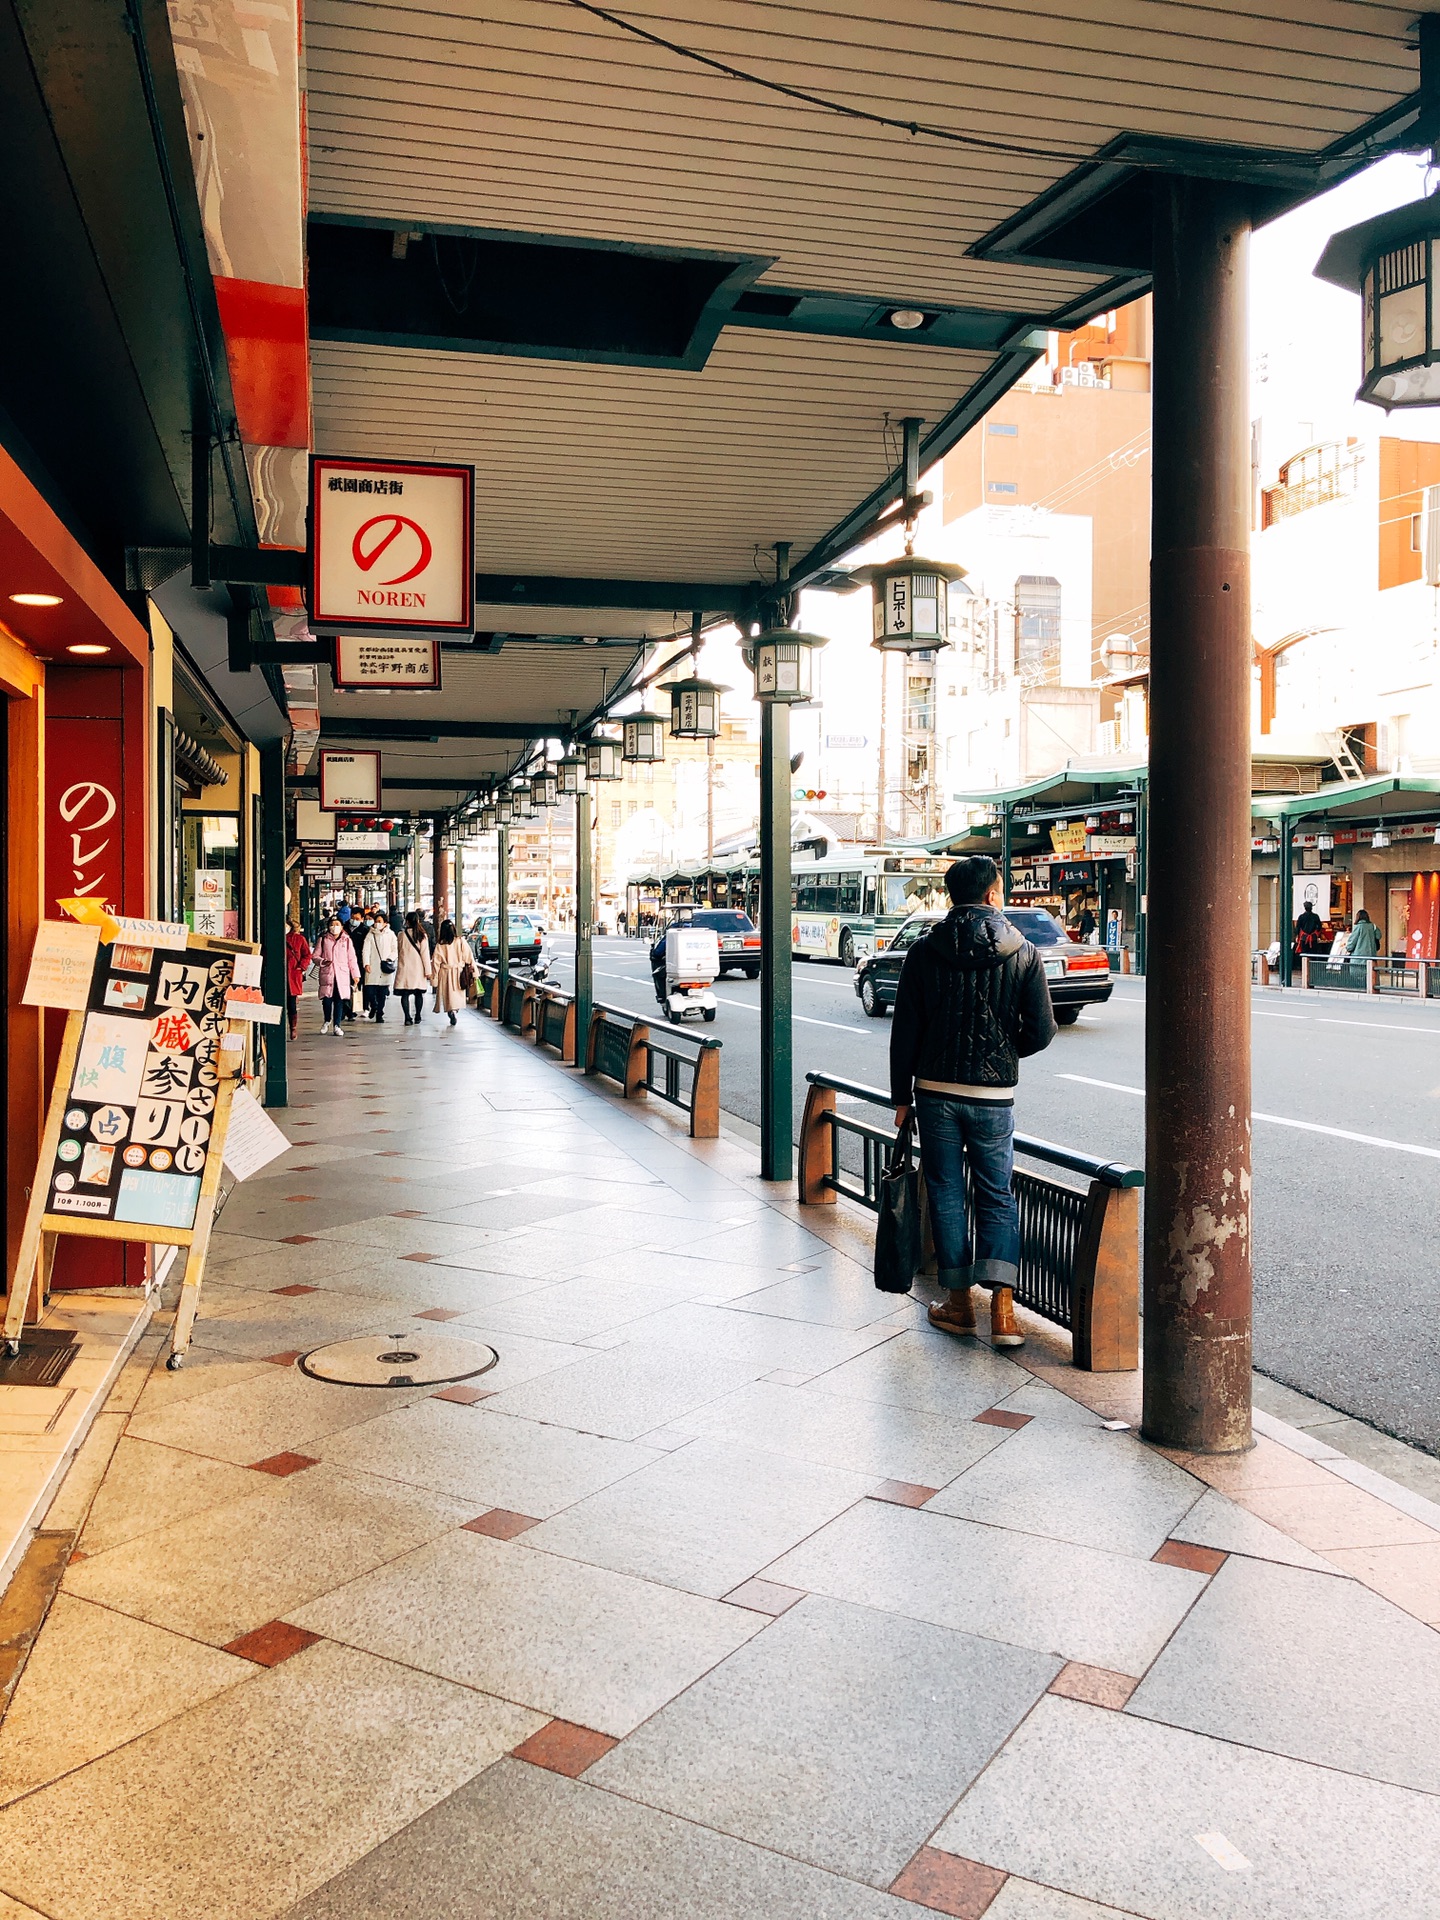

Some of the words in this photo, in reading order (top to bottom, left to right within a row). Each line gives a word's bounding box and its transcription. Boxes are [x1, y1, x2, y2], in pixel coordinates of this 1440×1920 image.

[357, 589, 427, 608] NOREN
[893, 580, 906, 631] ドロボーや
[378, 662, 429, 674] 宇野商店
[59, 782, 117, 897] のレン
[97, 1044, 128, 1074] 腹
[98, 1109, 122, 1136] 占
